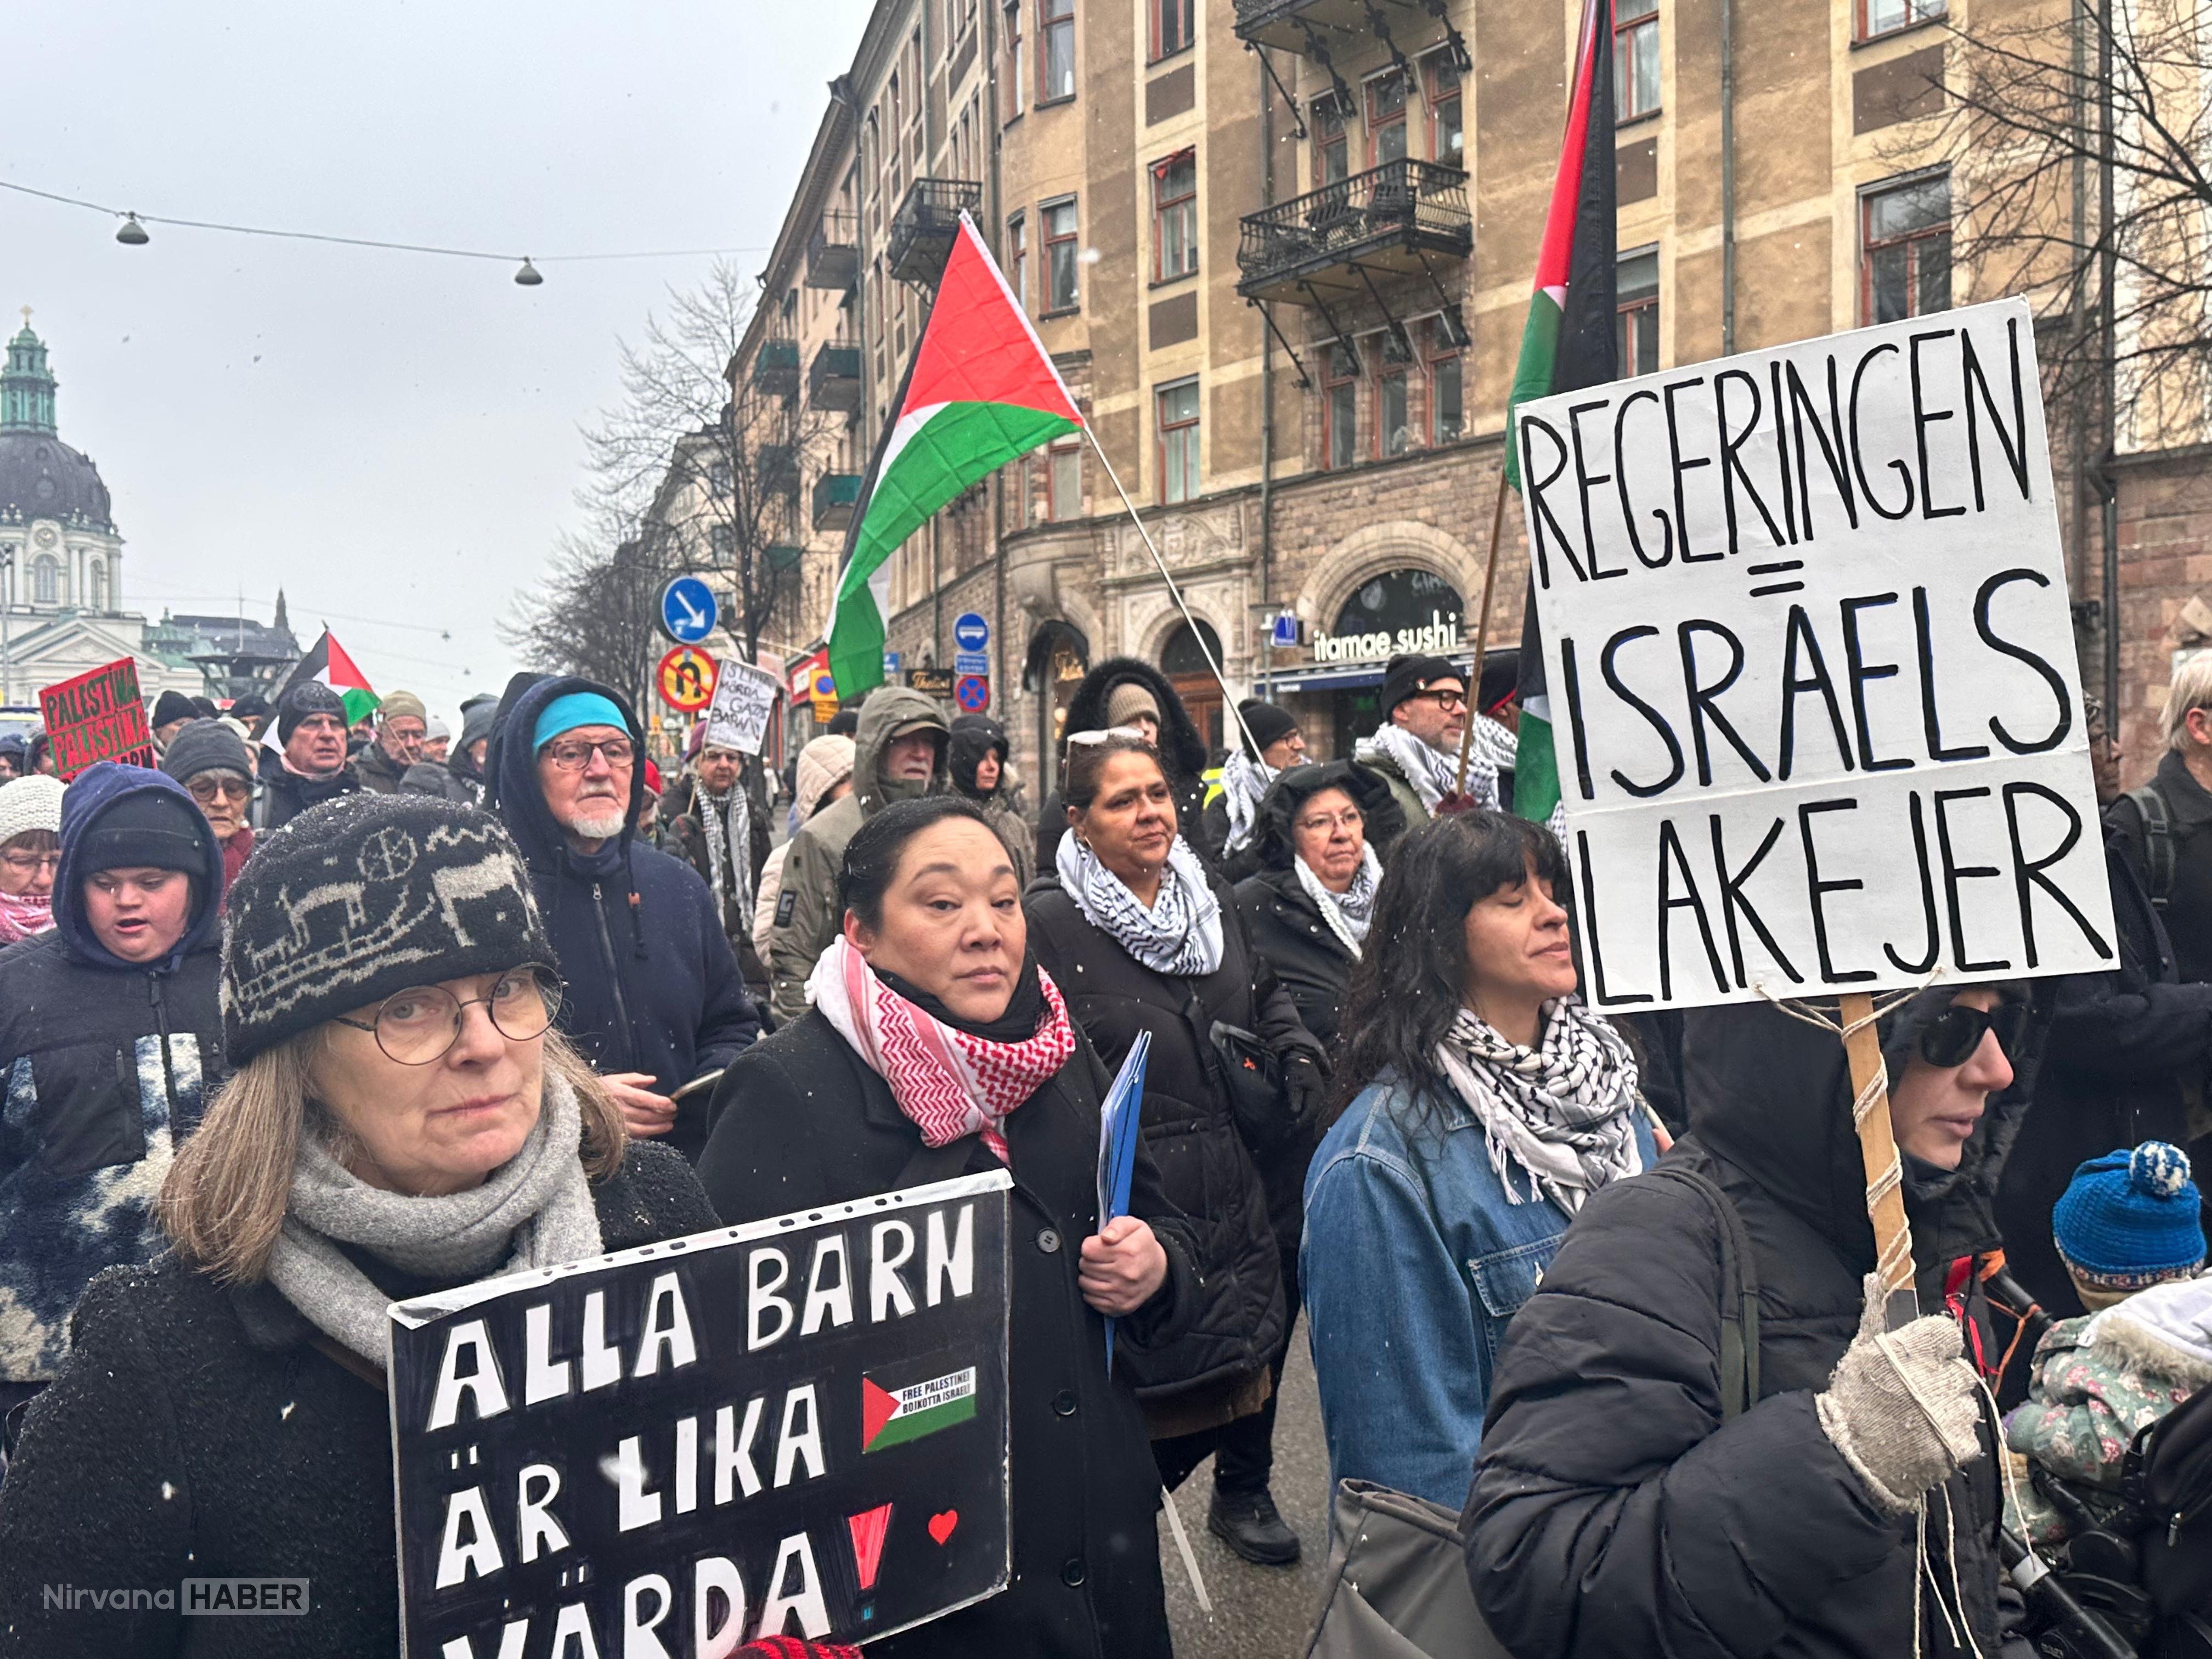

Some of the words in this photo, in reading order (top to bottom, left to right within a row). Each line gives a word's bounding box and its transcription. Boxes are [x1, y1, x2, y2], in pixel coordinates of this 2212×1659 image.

[1521, 318, 2032, 589] REGERINGEN
[1313, 630, 1391, 662] itamae
[1397, 609, 1457, 654] sushi
[1560, 568, 2072, 800] ISRAELS
[1578, 782, 2113, 1006] LAKEJER
[426, 1272, 697, 1433] ALLA
[746, 1204, 974, 1352] BARN
[902, 1387, 922, 1402] FREE
[925, 1370, 970, 1394] PALESTINE!
[902, 1394, 941, 1414] BOJKOTTA
[943, 1384, 970, 1400] ISRAEL!
[435, 1445, 571, 1590] ÄR
[618, 1383, 827, 1533] LIKA
